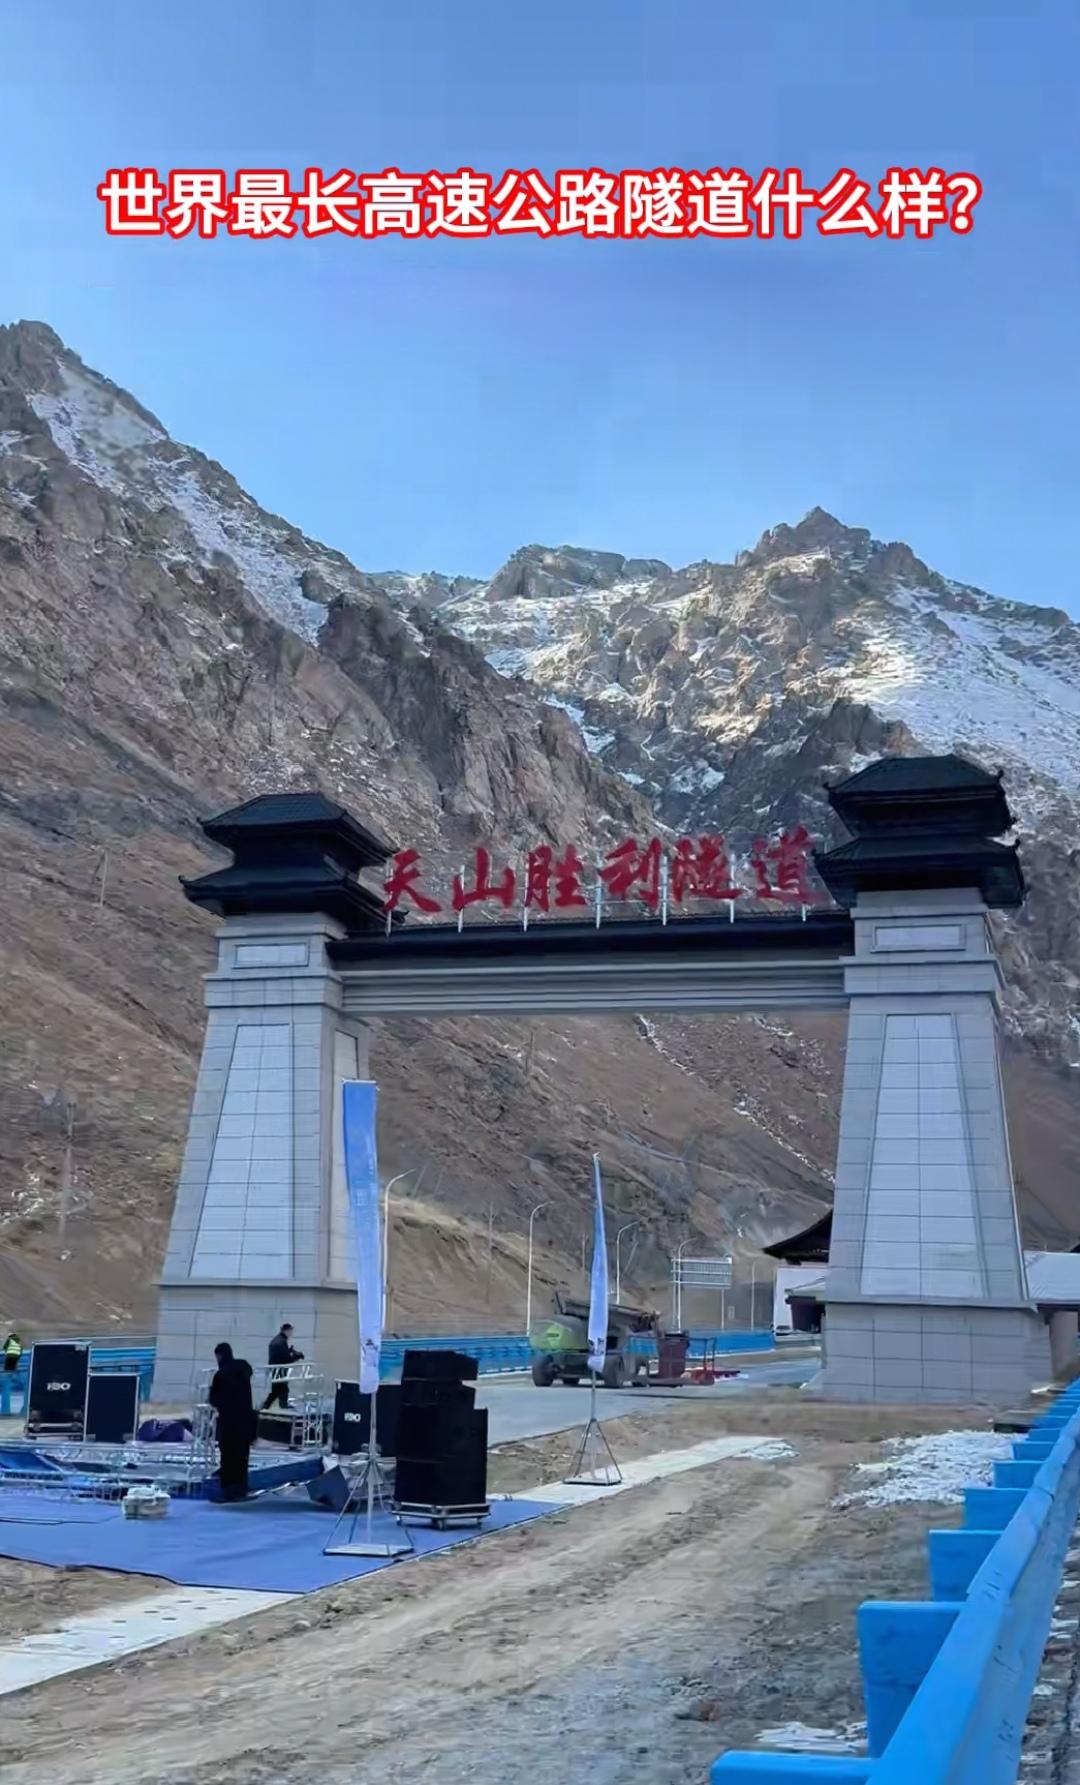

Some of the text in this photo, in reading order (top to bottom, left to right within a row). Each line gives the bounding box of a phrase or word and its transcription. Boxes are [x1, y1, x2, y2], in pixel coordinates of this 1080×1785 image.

[384, 826, 817, 912] 天山胜利隧道
